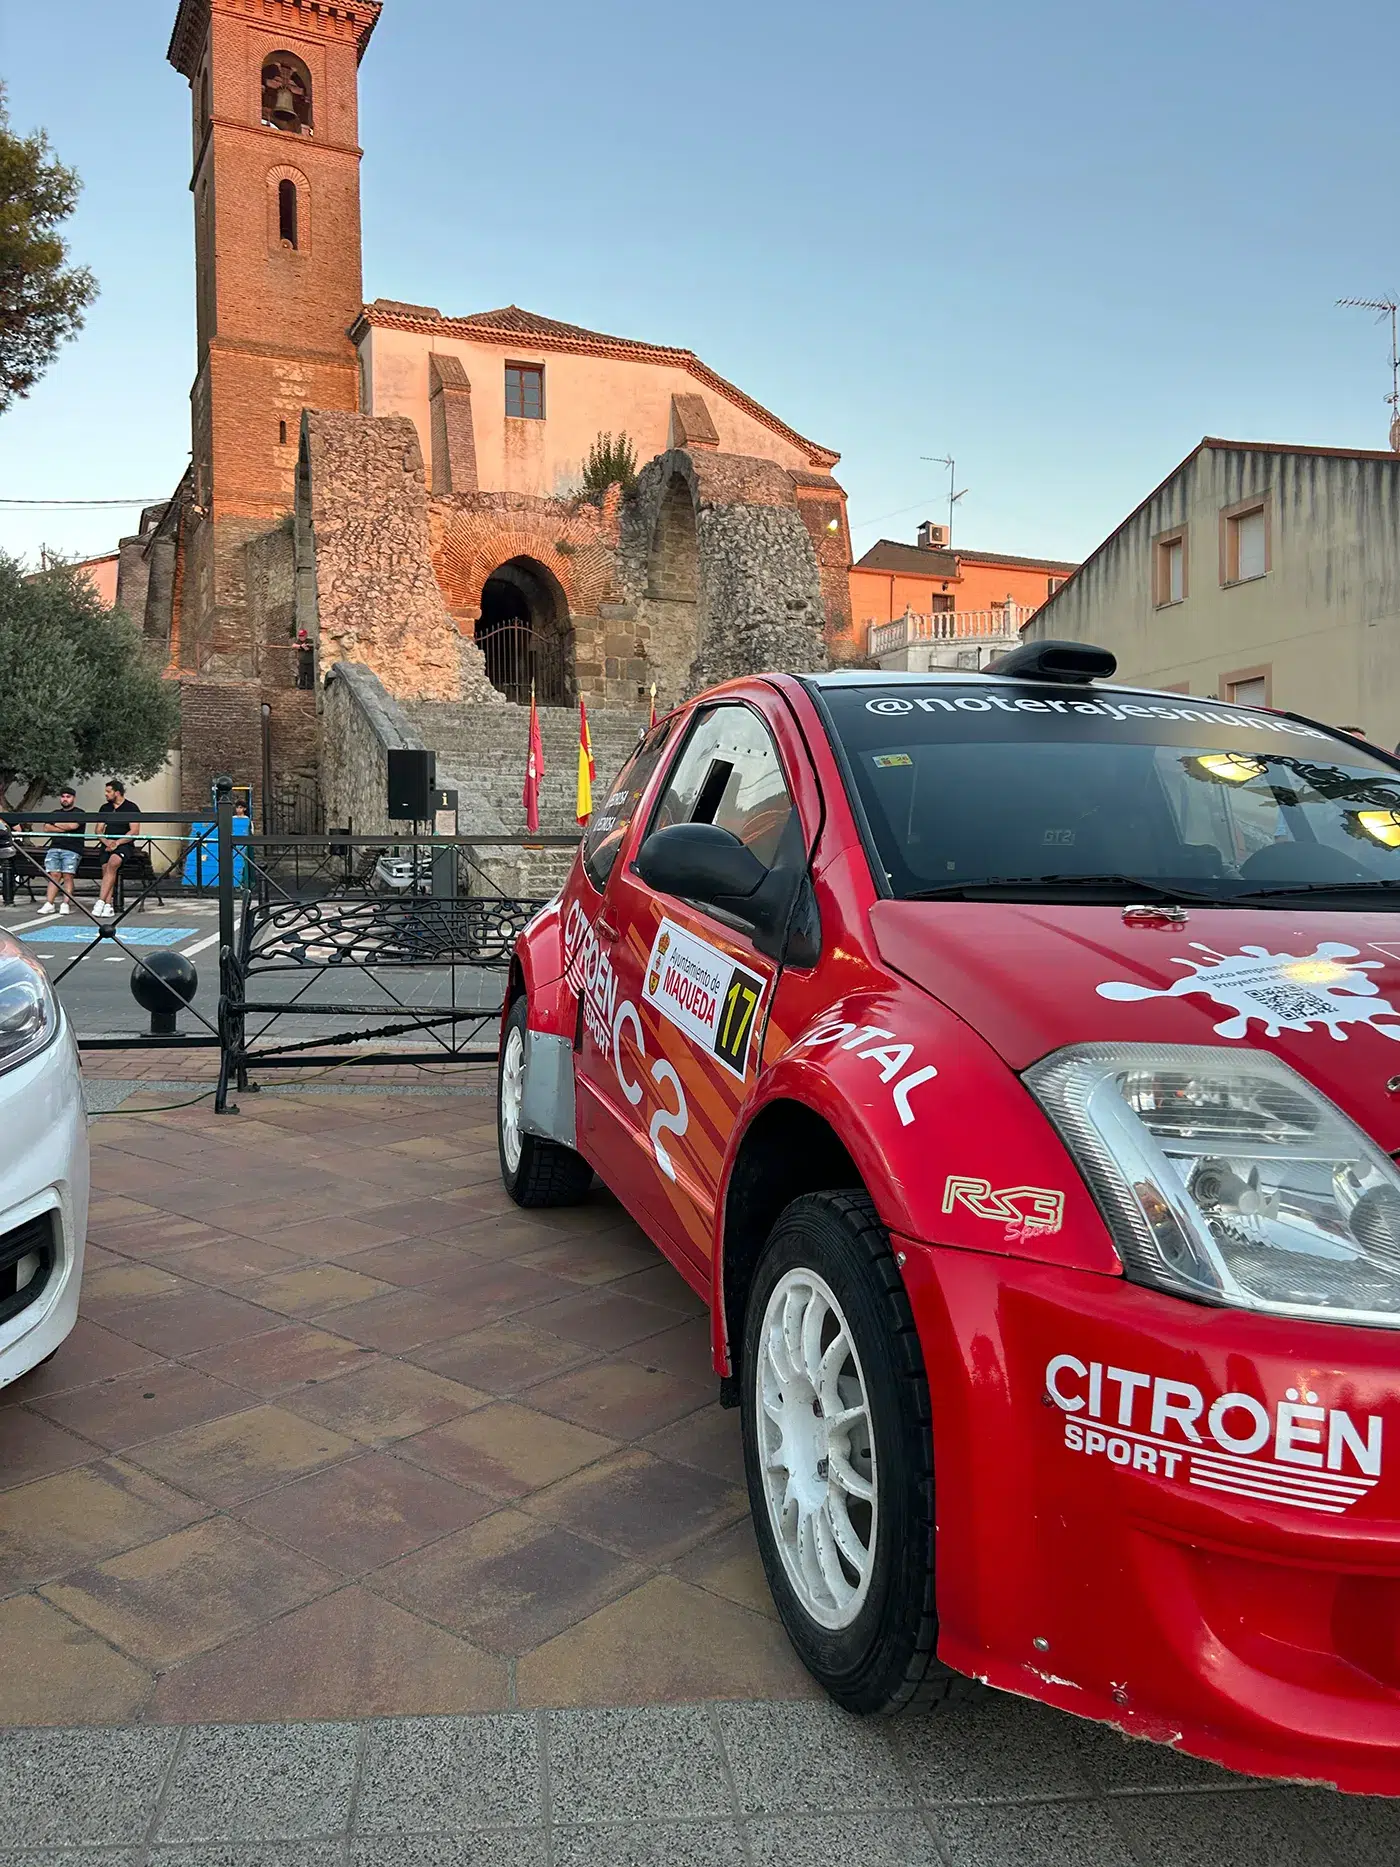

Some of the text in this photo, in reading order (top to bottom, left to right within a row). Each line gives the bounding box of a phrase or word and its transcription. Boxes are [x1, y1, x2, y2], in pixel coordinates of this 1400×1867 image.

[865, 695, 1335, 742] @noterajesnunca
[662, 965, 717, 1030] MAQUEDA
[669, 946, 721, 995] Ayuntamiento de
[1196, 971, 1236, 982] Busco
[1212, 975, 1269, 989] Proyecto
[584, 1003, 611, 1061] SPORT
[727, 981, 757, 1057] 17
[1045, 1354, 1383, 1476] CITROËN
[1064, 1424, 1182, 1478] SPORT
